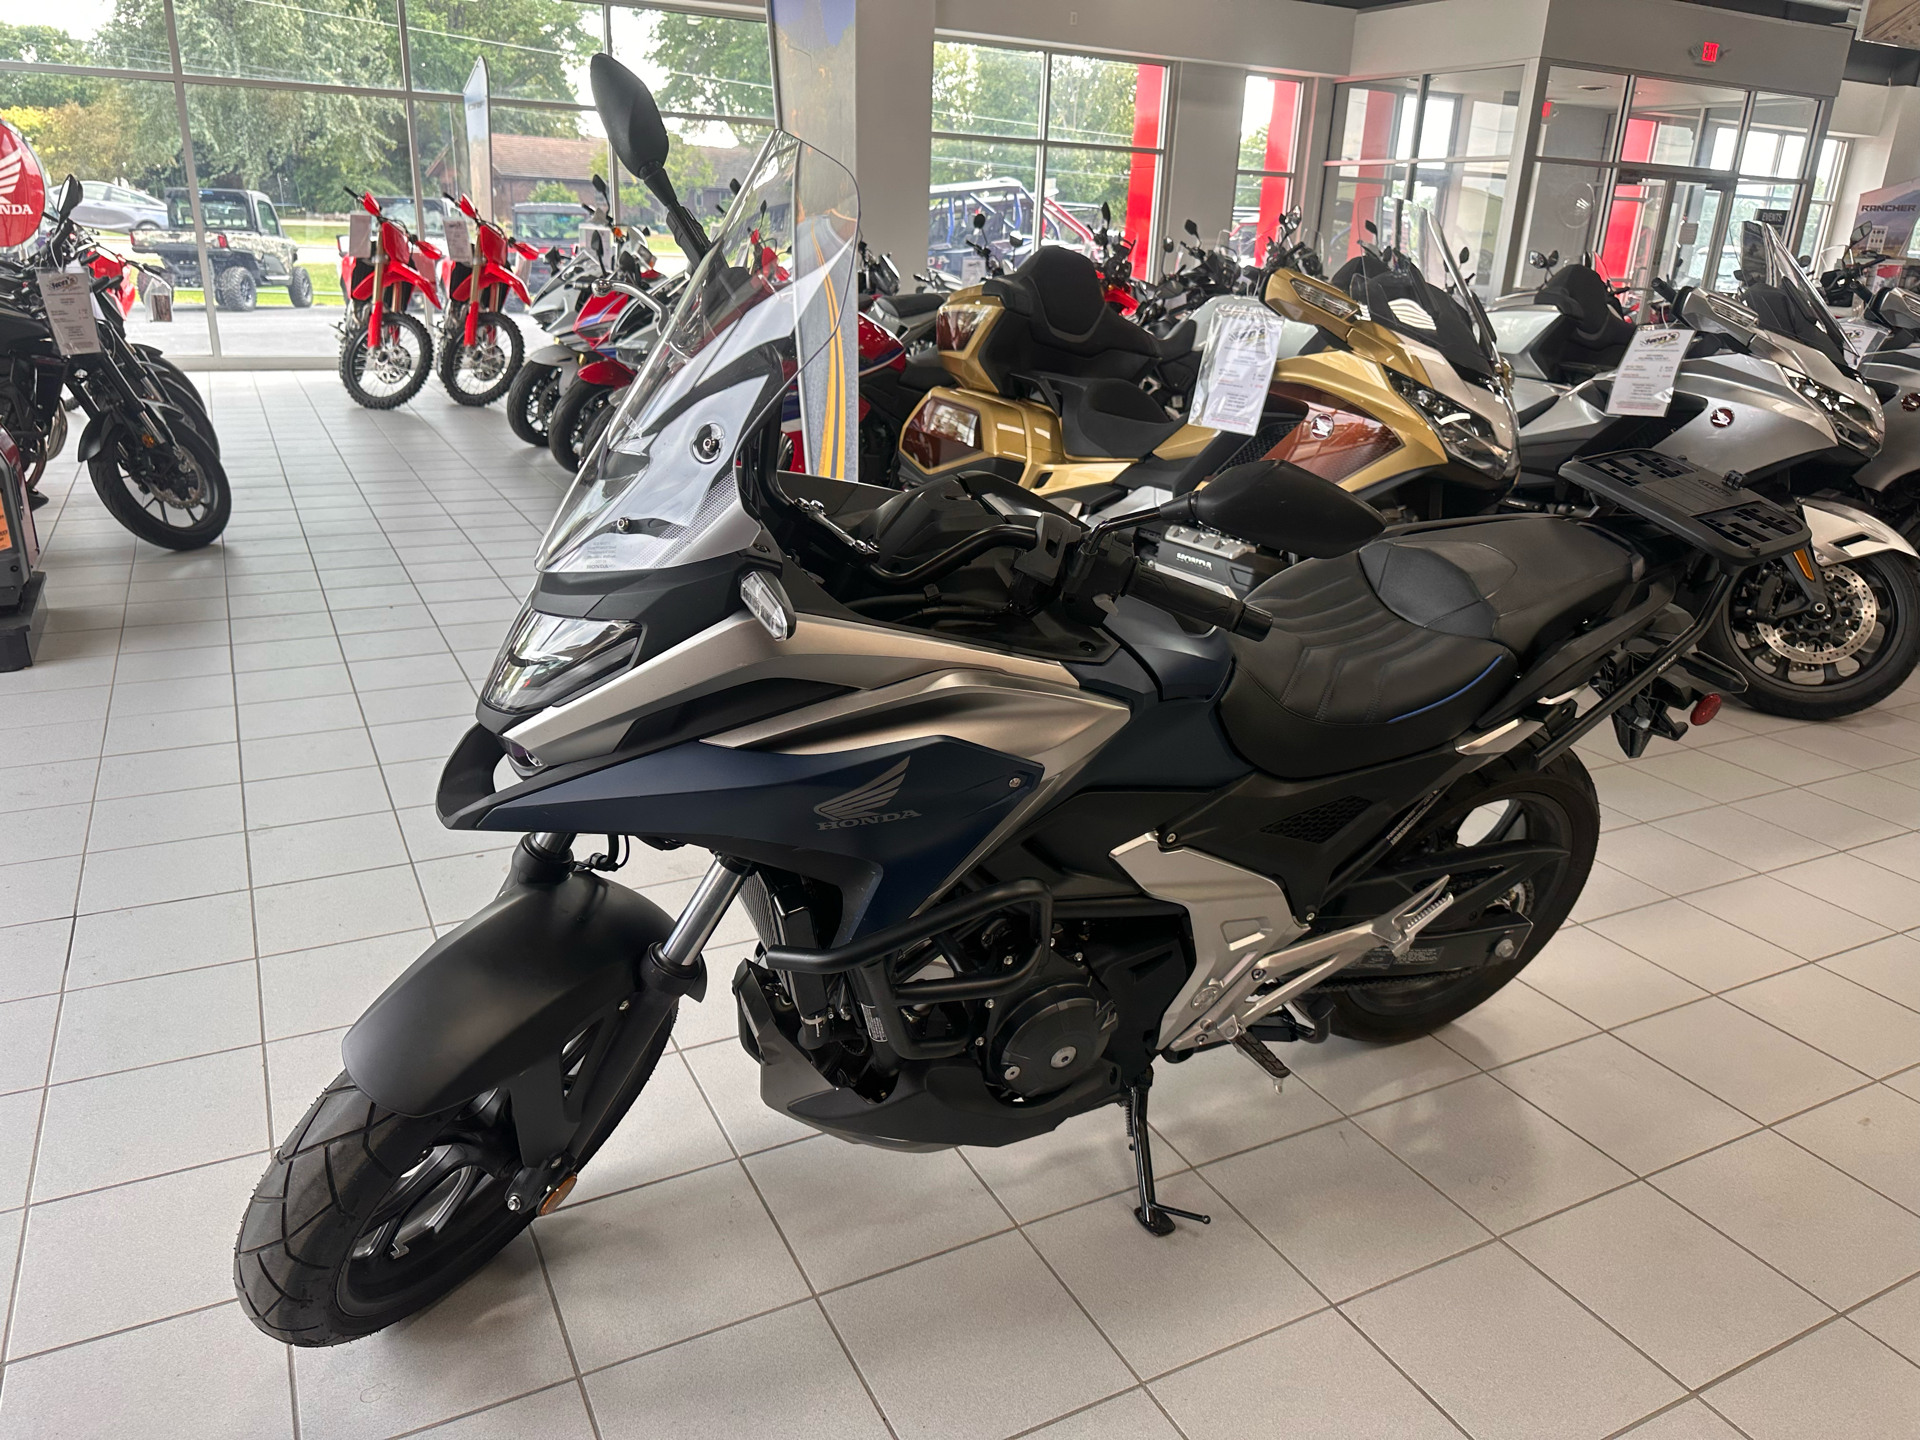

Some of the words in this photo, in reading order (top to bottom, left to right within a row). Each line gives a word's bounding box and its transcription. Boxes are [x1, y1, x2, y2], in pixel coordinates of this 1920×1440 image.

[1860, 204, 1918, 213] RANCHER
[1761, 211, 1783, 223] EVENTS
[816, 809, 922, 831] HONDA
